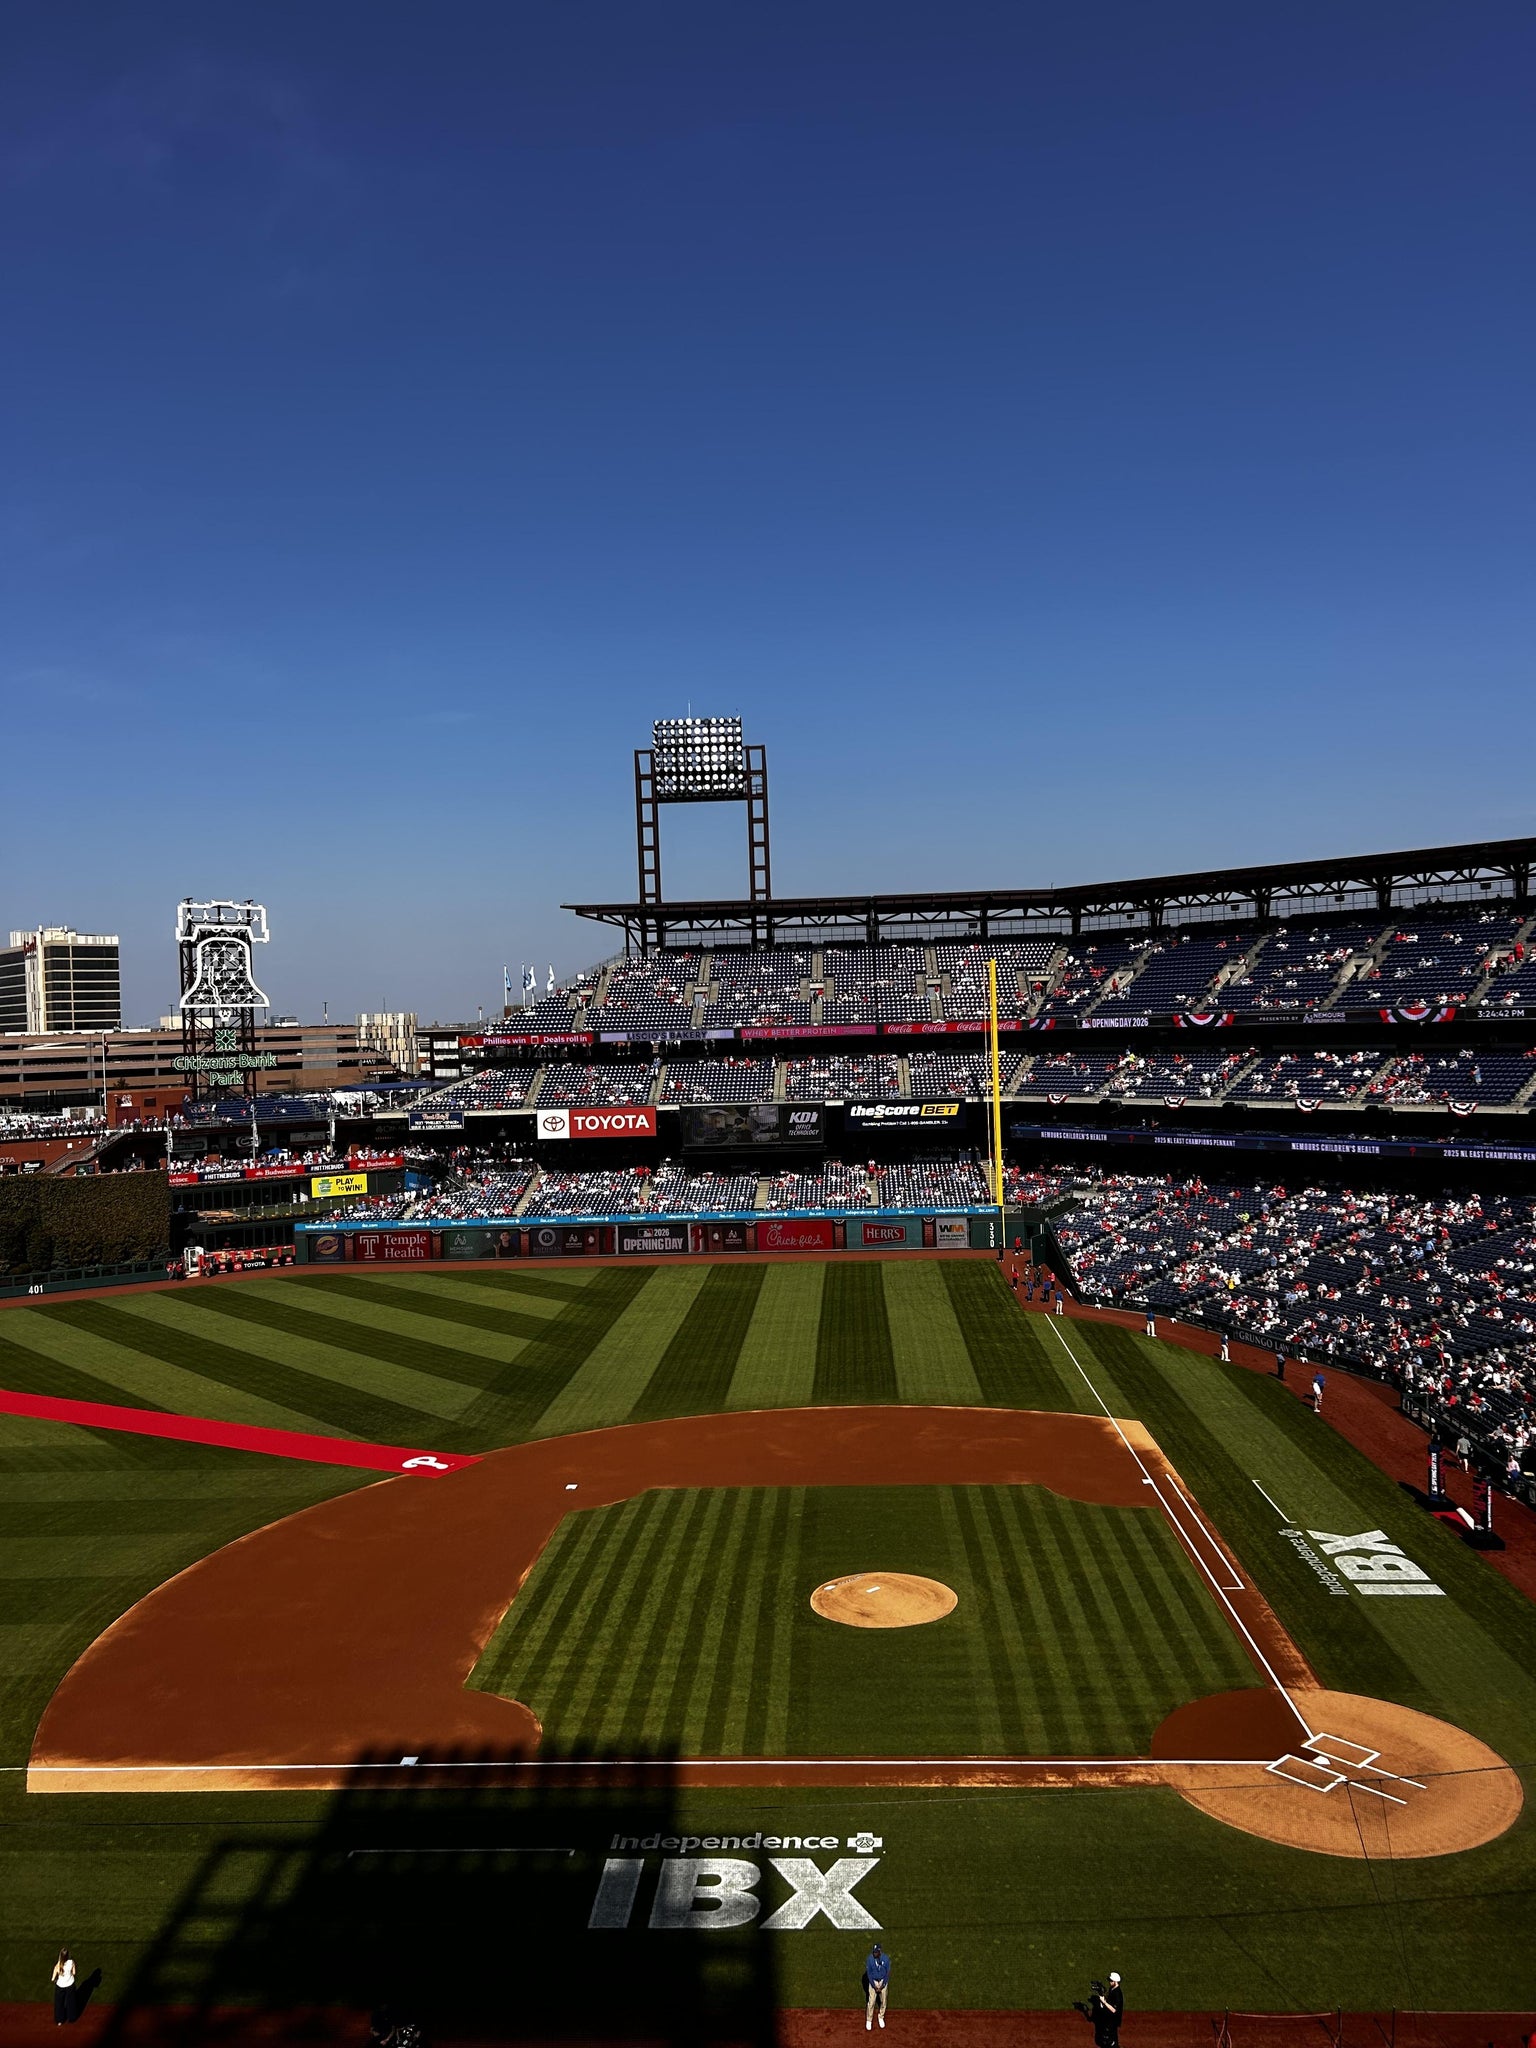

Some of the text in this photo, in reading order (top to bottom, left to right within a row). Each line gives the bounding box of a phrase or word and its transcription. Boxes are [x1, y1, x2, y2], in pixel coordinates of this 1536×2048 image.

[1477, 1010, 1510, 1018] 3:24:42
[888, 1024, 913, 1033] Coca-Cola
[922, 1023, 947, 1032] Coca-Cola
[956, 1022, 982, 1032] Coca-Cola
[1092, 1018, 1149, 1028] OPENING DAY 2026
[627, 1032, 667, 1040] LISCIO'S
[174, 1052, 278, 1070] Citizens Bank
[210, 1070, 244, 1086] Park
[850, 1104, 956, 1118] theScore BET
[573, 1114, 650, 1130] TOYOTA
[1040, 1131, 1108, 1141] NEMOURS CHILDREN'S HEALTH
[1154, 1136, 1236, 1147] 2025 NL EAST CHAMPIONS PENNANT
[1291, 1142, 1380, 1154] NEMOURS CHILDREN'S HEALTH
[1443, 1149, 1460, 1158] 2025
[1460, 1150, 1468, 1158] NL
[1469, 1150, 1484, 1159] EAST
[1485, 1151, 1522, 1160] CHAMPIONS
[310, 1163, 345, 1172] #HITTHEBUDS
[366, 1159, 397, 1168] Budweiser
[204, 1172, 241, 1180] #HITTHEBUDS
[264, 1168, 297, 1176] Budweiser
[866, 1227, 901, 1239] HERR'S
[383, 1234, 427, 1247] Temple
[623, 1238, 683, 1251] OPENING DAY
[384, 1247, 424, 1258] Health
[28, 1284, 44, 1295] 401
[1239, 1330, 1290, 1353] GRUNGO LAW
[1289, 1537, 1350, 1596] Independence
[1306, 1529, 1447, 1596] IBX
[610, 1832, 840, 1854] Independence
[587, 1858, 884, 1930] IBX
